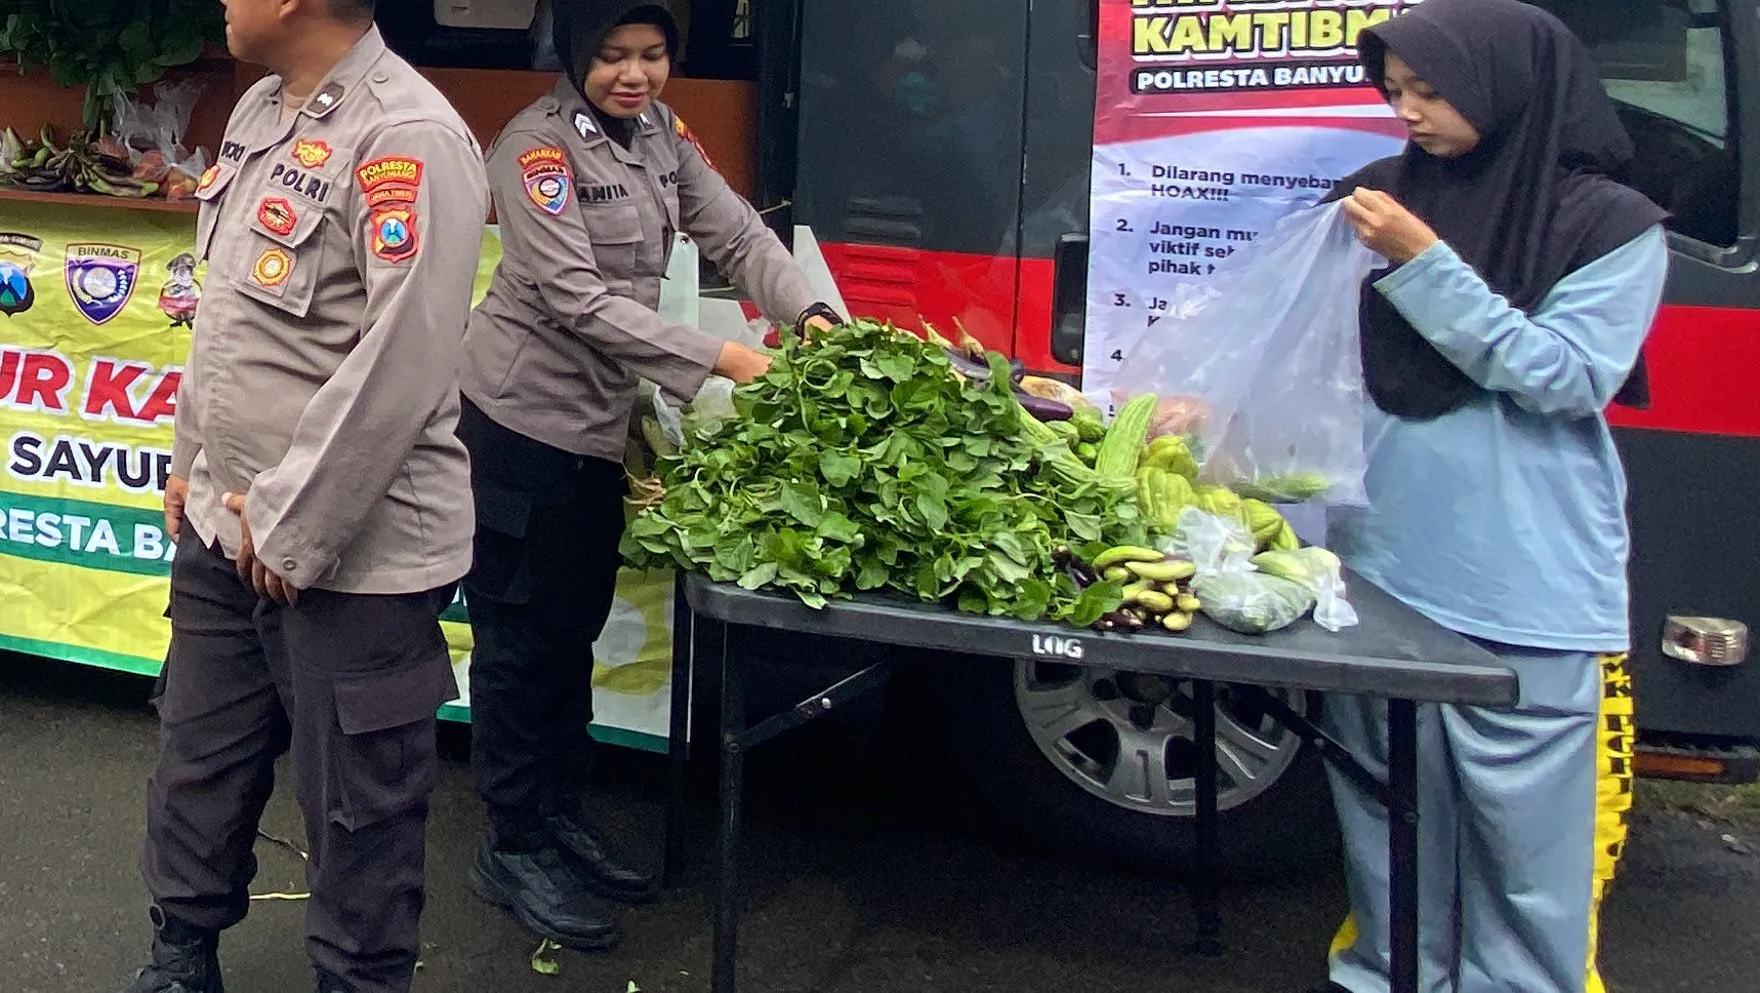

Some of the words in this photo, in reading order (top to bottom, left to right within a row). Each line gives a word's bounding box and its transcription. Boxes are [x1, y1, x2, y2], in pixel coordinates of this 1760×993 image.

[1134, 9, 1391, 53] KAMTIBM
[1138, 69, 1269, 90] POLRESTA
[1274, 65, 1364, 86] BANYU
[360, 161, 417, 180] POLRESTA
[1118, 163, 1131, 176] 1.
[1152, 165, 1235, 185] Dilarang
[1241, 174, 1341, 191] menyebar
[270, 163, 329, 202] POLRI
[1151, 184, 1229, 202] HOAX!!!
[1116, 219, 1134, 233] 2.
[1150, 221, 1220, 240] Jangan
[78, 246, 130, 260] BINMAS
[1150, 240, 1200, 257] viktif
[1149, 258, 1202, 275] pihak
[1114, 293, 1131, 307] 3.
[85, 360, 183, 422] KA
